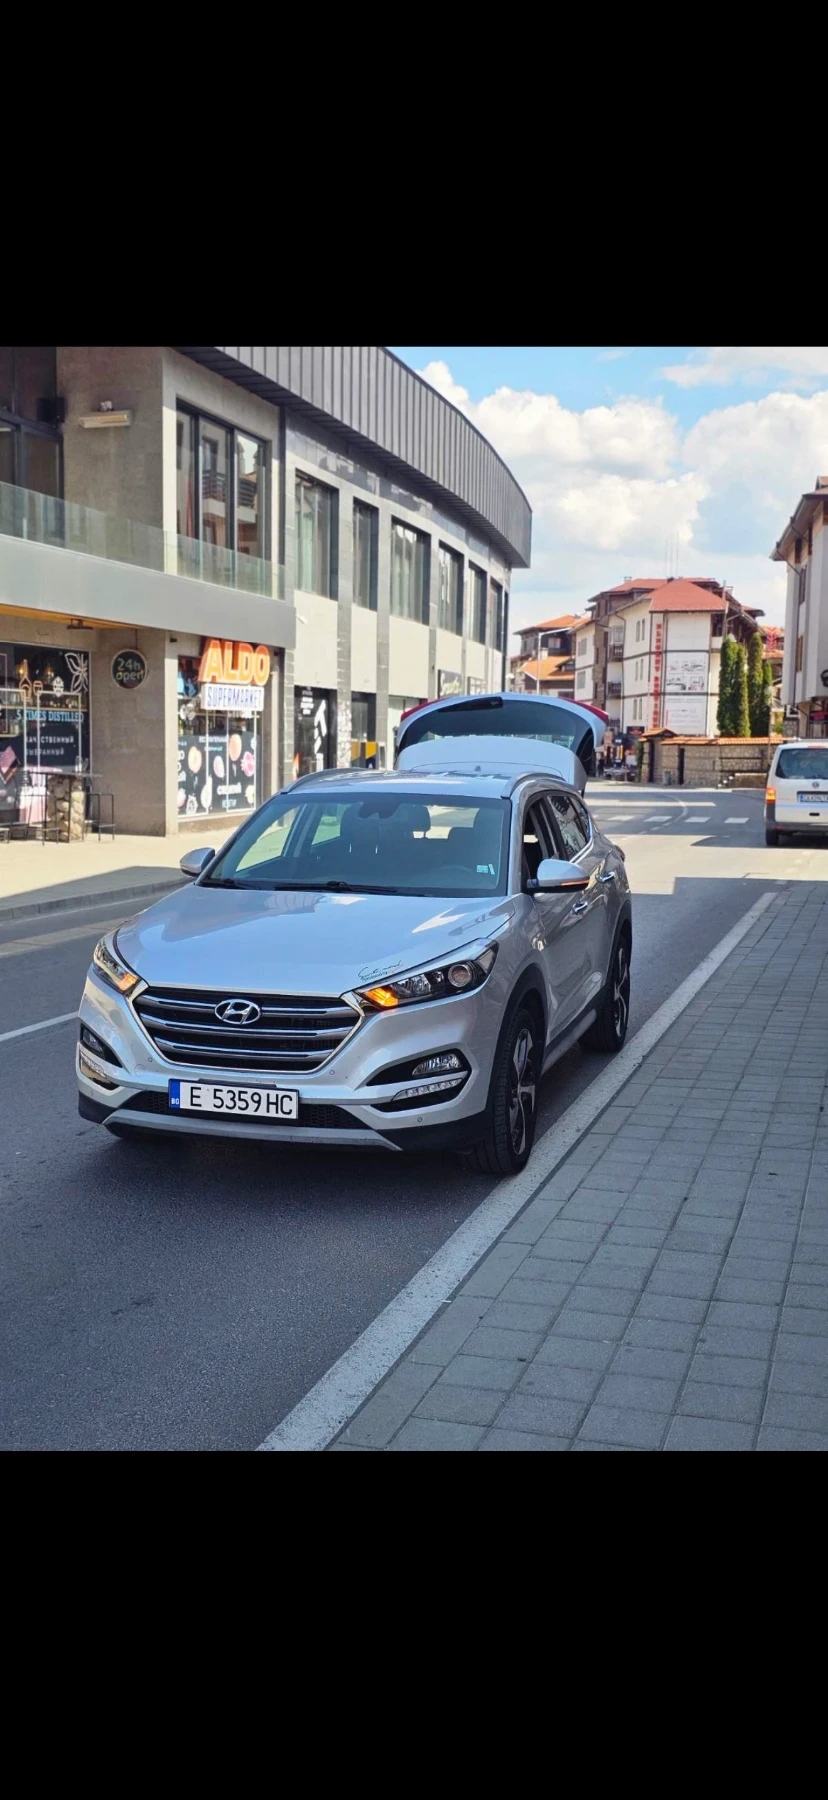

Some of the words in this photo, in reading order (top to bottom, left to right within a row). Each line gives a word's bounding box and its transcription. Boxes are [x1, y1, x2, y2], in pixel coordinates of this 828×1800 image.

[117, 658, 141, 671] 24h
[200, 639, 270, 686] ALDO
[116, 670, 144, 683] open
[207, 686, 262, 708] SUPERMARKET
[16, 709, 22, 721] 5
[48, 711, 84, 723] DISTILLED
[171, 1097, 179, 1105] BG
[190, 1086, 202, 1107] E
[213, 1088, 261, 1113] 5359
[266, 1093, 293, 1115] HC
